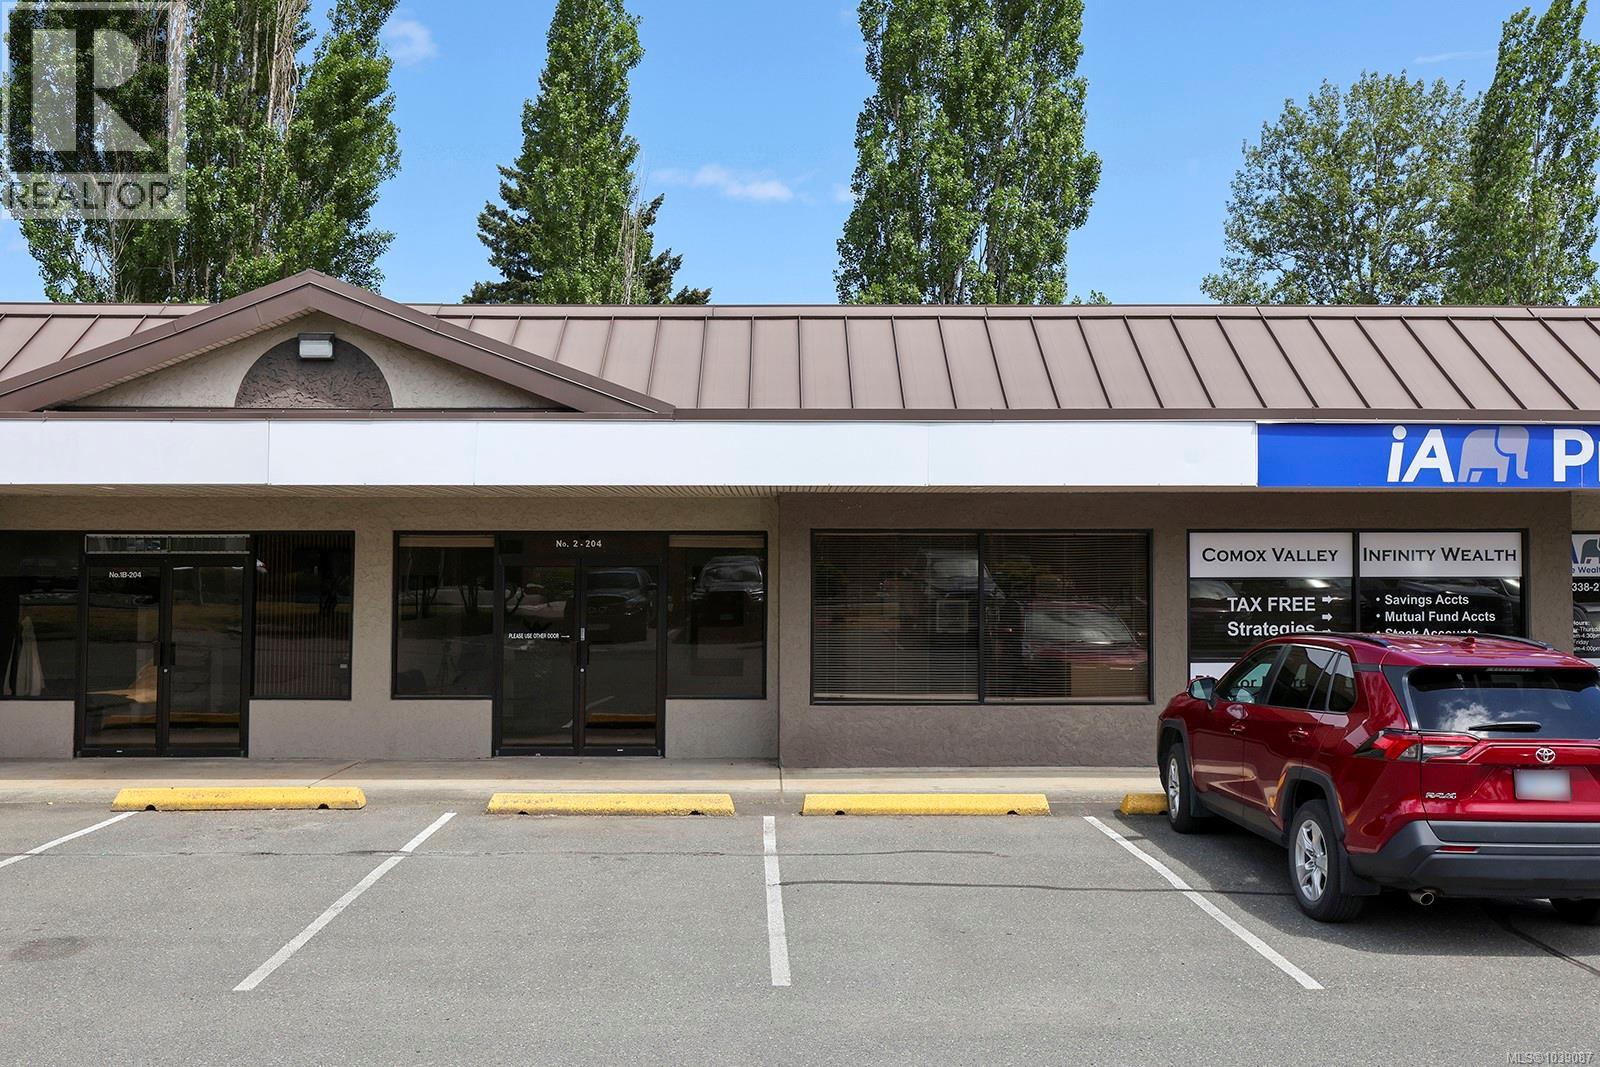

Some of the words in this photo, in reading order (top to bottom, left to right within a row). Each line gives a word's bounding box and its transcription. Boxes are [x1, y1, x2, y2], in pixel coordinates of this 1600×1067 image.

[1553, 428, 1600, 482] P
[1202, 548, 1267, 562] COMOX
[1271, 548, 1338, 562] VALLEY
[1363, 547, 1436, 562] INFINITY
[1441, 547, 1517, 562] WEALTH
[1571, 582, 1600, 592] 338-2
[1227, 597, 1262, 612] TAX
[1267, 597, 1316, 612] FREE
[1384, 594, 1433, 608] Savings
[1435, 594, 1470, 605] Accts
[1384, 611, 1425, 622] Mutual
[1428, 611, 1459, 622] Fund
[1461, 611, 1496, 622] Accts
[1227, 621, 1316, 637] Strategies
